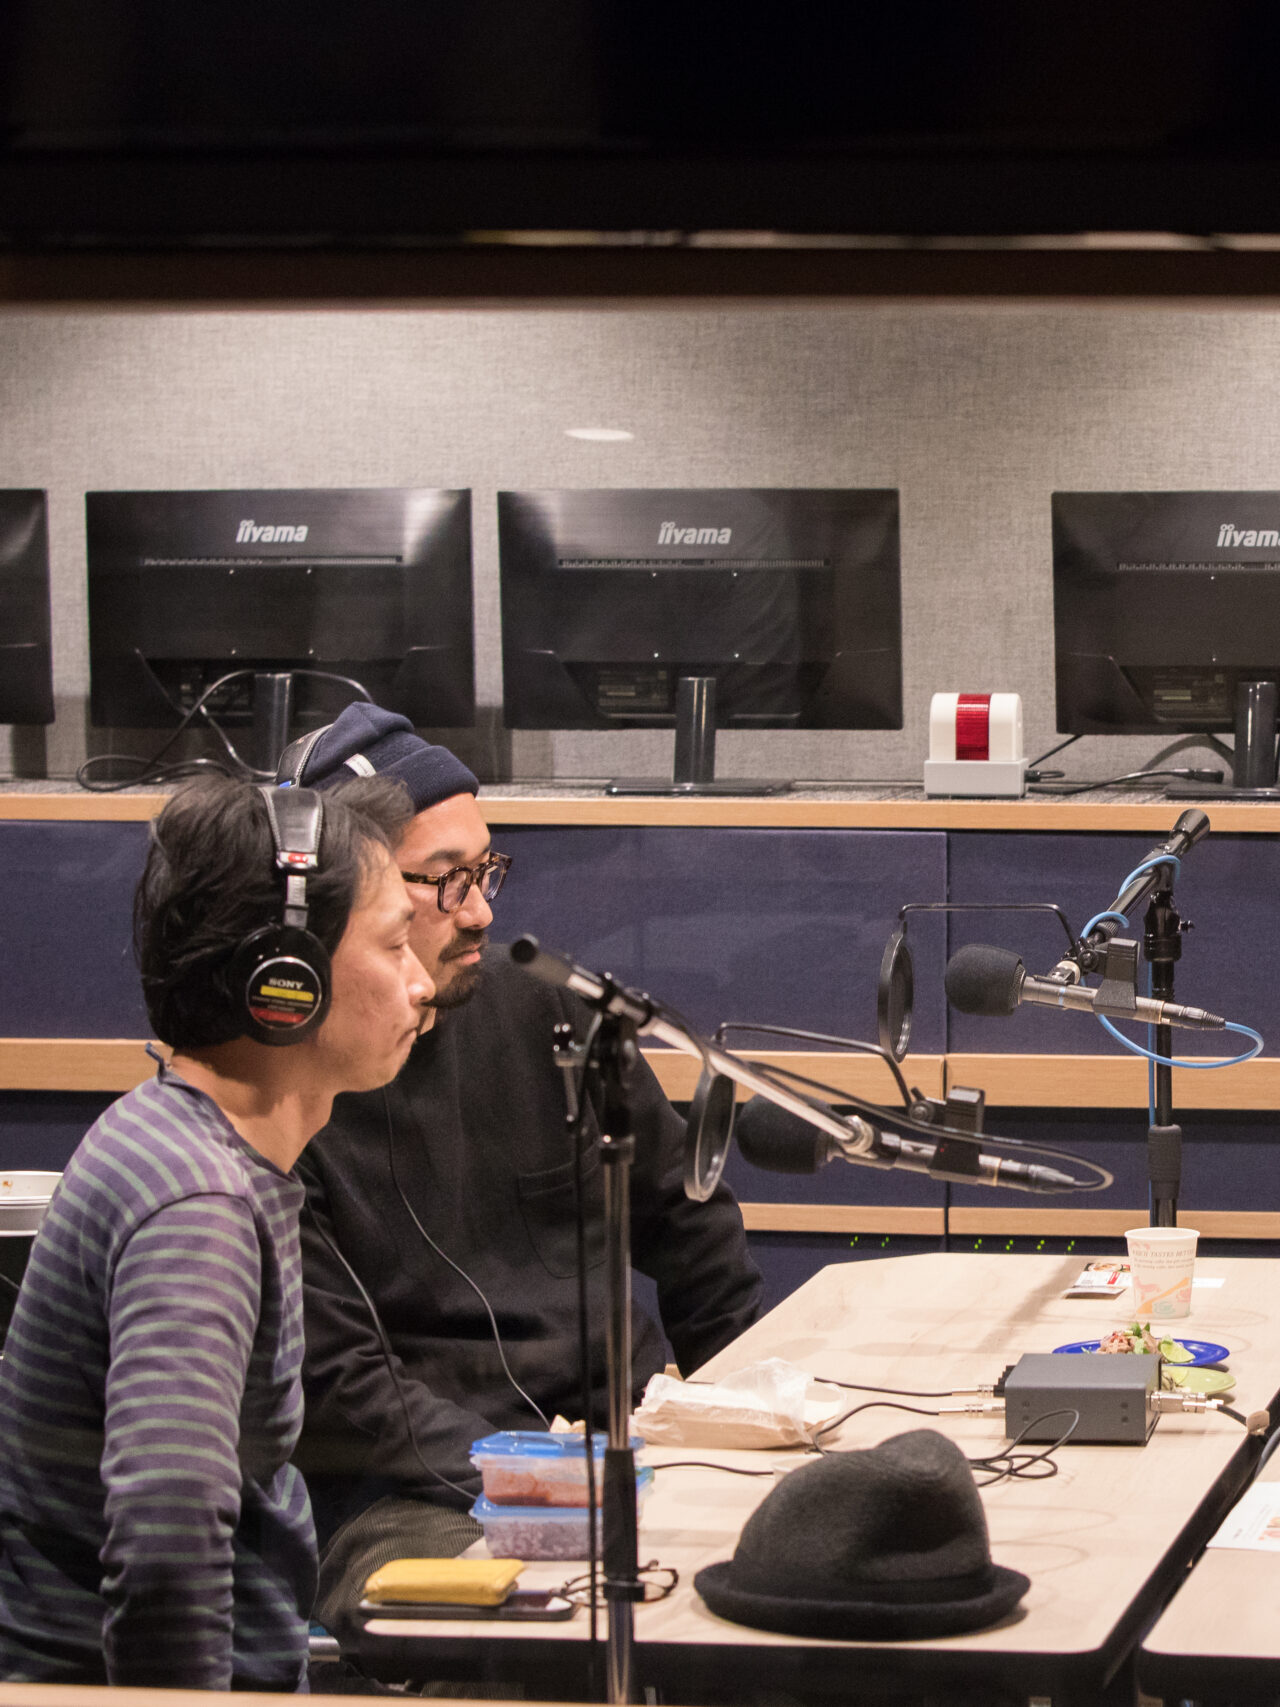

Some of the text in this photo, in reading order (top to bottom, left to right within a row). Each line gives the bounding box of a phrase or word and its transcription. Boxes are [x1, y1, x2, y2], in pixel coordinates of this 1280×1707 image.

[236, 520, 309, 543] iiyama
[656, 521, 732, 545] iiyama
[268, 977, 304, 990] SONY
